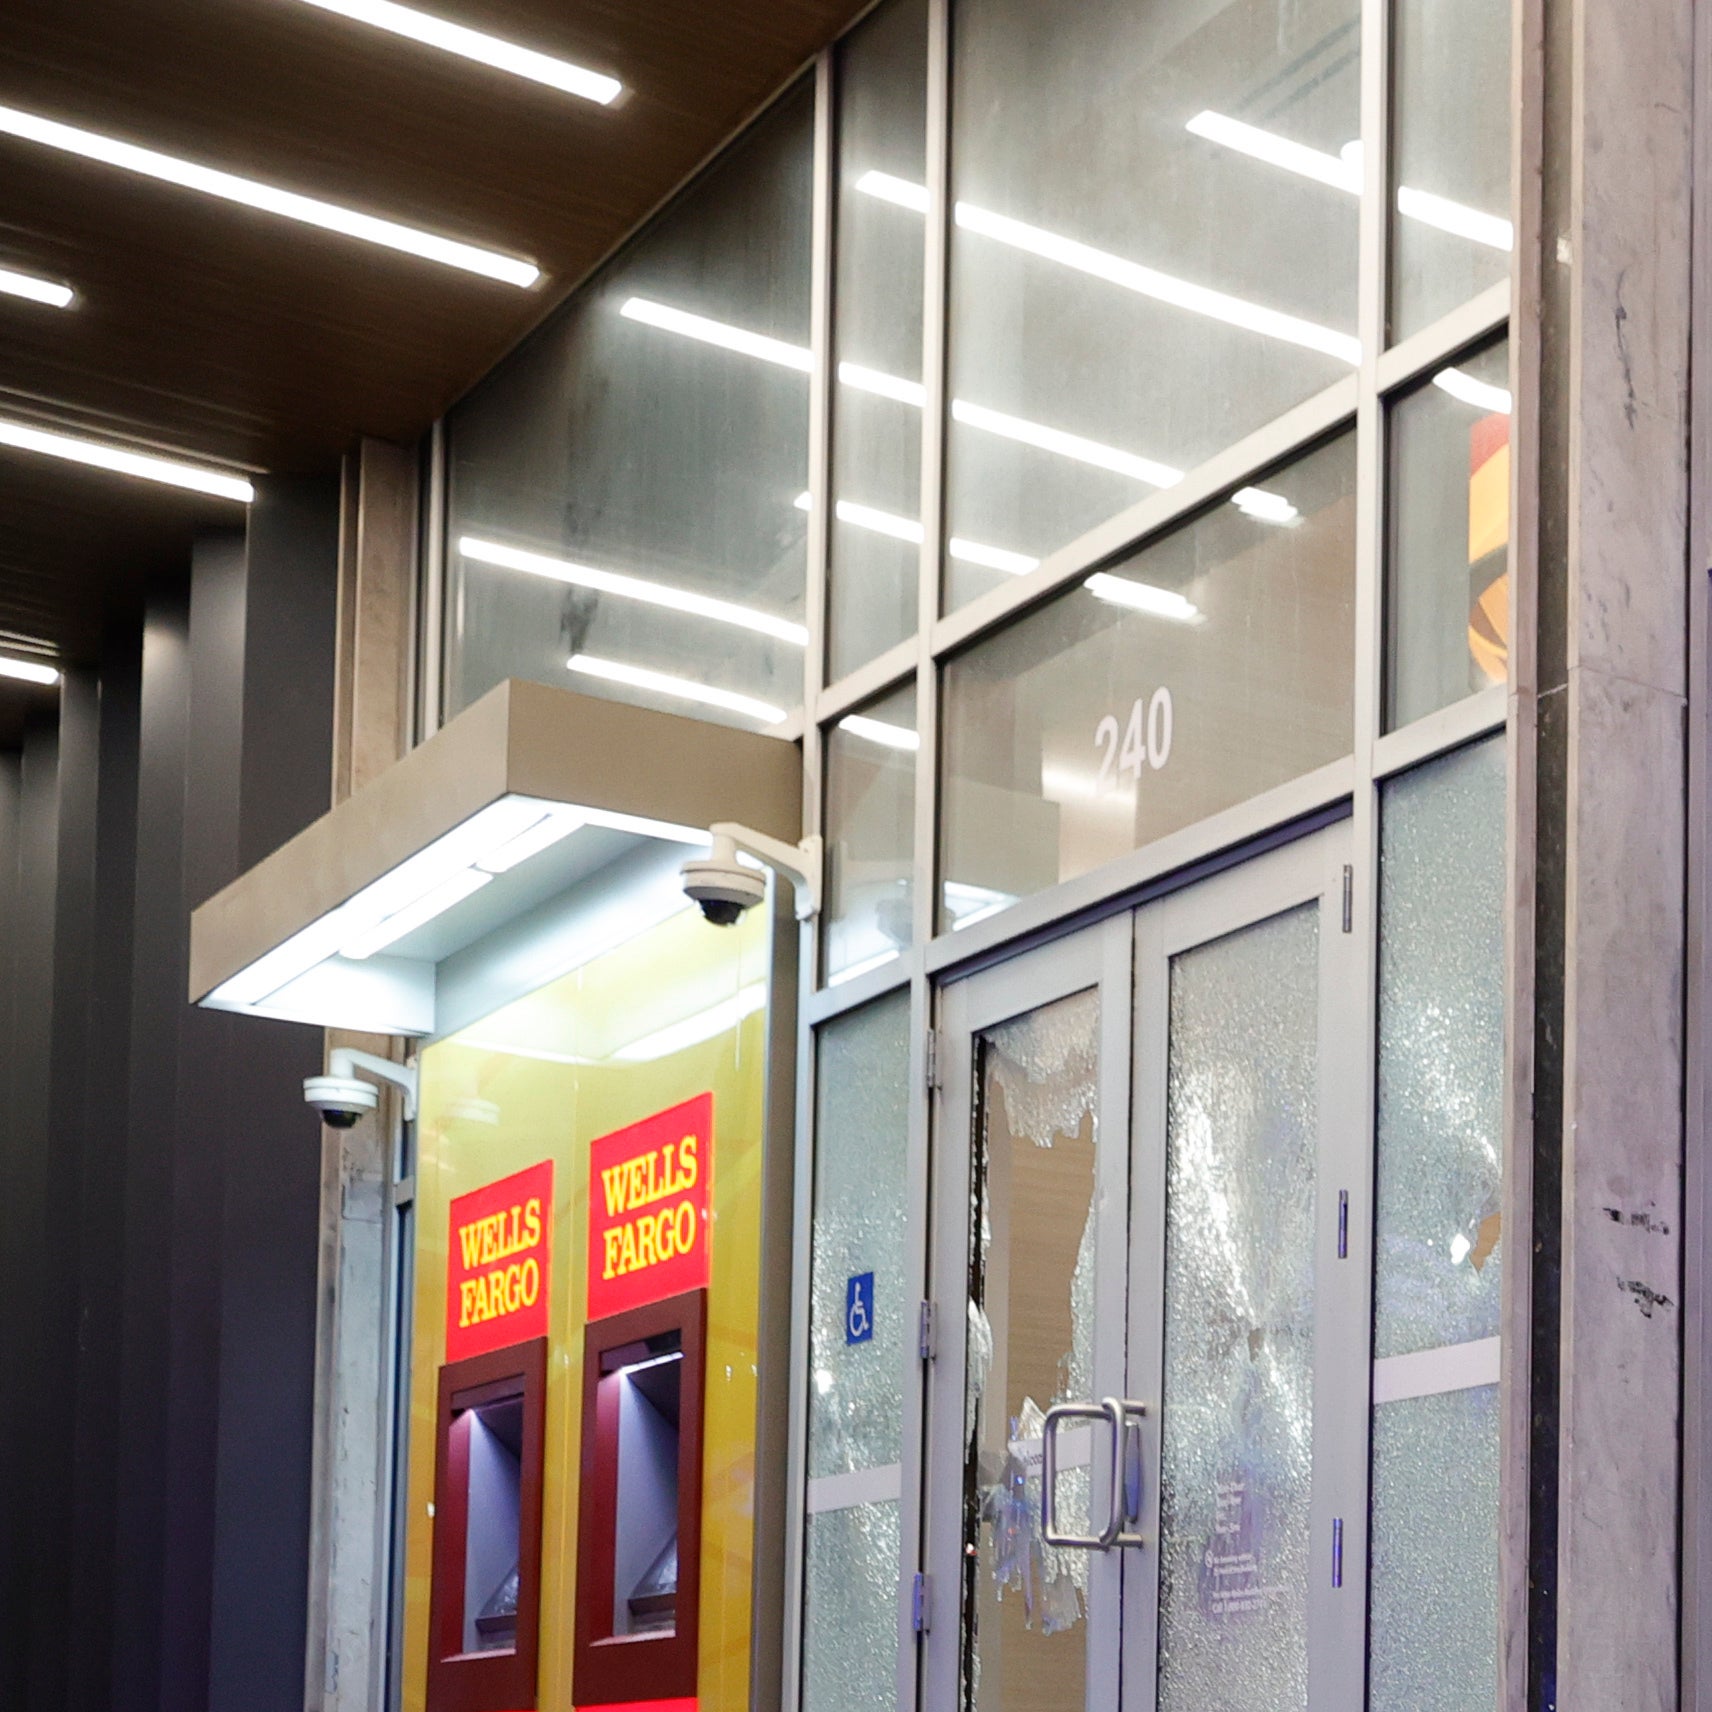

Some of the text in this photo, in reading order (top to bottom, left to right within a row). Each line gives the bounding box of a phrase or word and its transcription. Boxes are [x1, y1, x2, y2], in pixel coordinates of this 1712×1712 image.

[1094, 686, 1173, 790] 240
[601, 1135, 697, 1217] WELLS
[459, 1198, 541, 1270] WELLS
[602, 1201, 696, 1280] FARGO
[459, 1258, 540, 1328] FARGO
